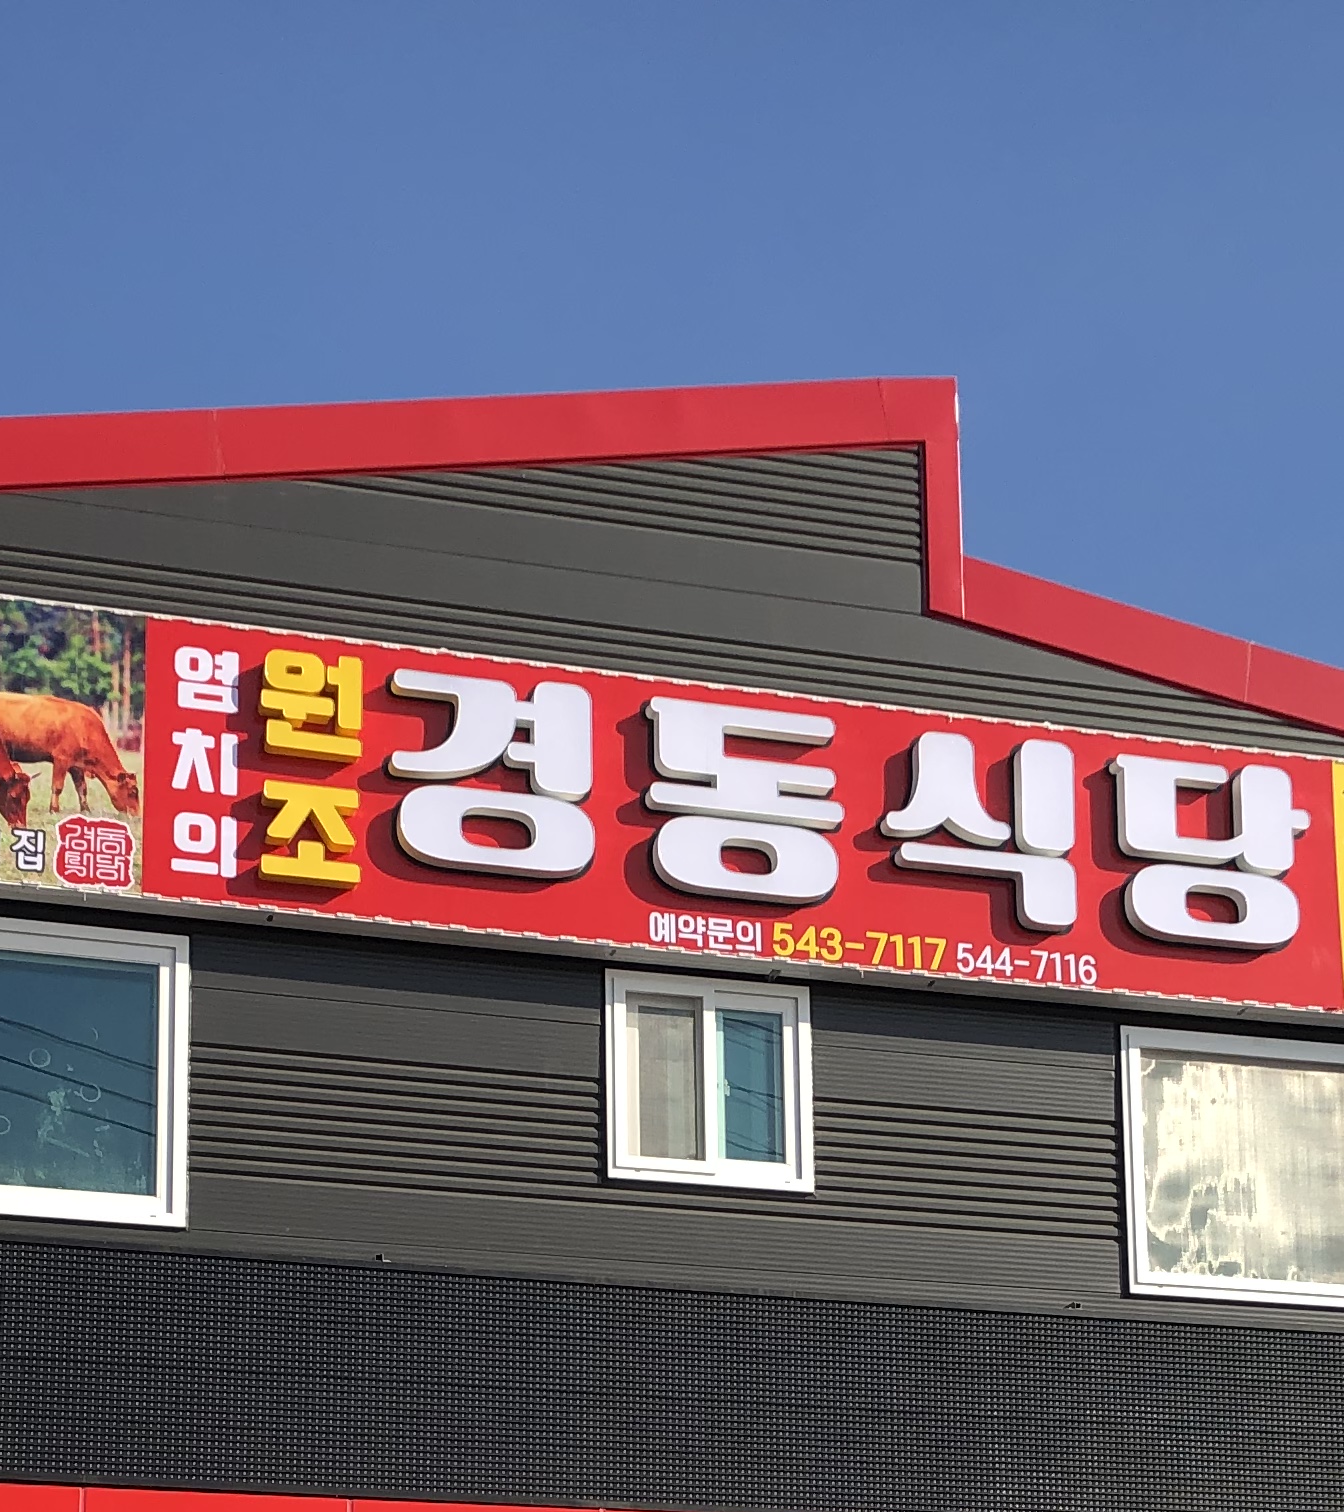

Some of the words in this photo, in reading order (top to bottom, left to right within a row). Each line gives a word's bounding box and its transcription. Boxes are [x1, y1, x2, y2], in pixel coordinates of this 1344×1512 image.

[9, 825, 46, 873] 집
[171, 645, 239, 879] 염치의
[259, 648, 364, 890] 원조
[387, 667, 1311, 951] 경동식당
[649, 911, 763, 953] 예약문의
[772, 922, 947, 973] 543-7117
[956, 948, 1098, 987] 544-7116
